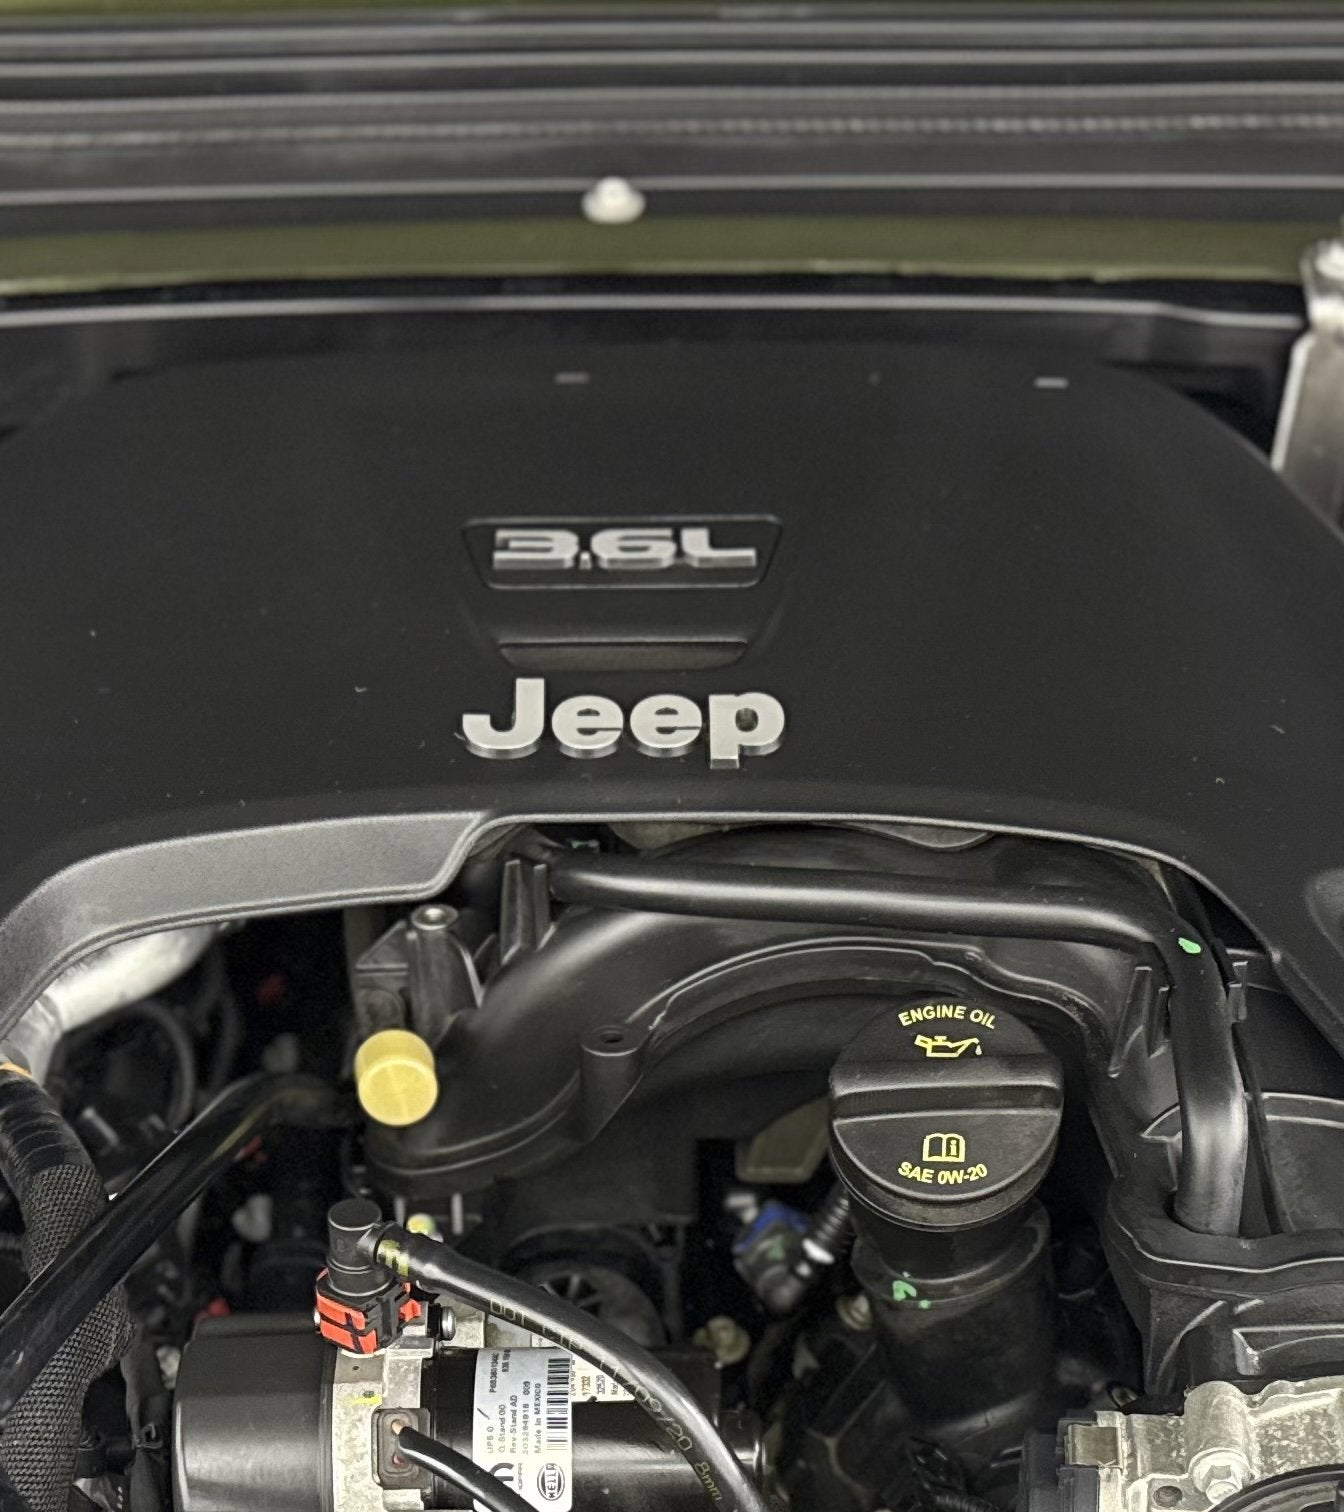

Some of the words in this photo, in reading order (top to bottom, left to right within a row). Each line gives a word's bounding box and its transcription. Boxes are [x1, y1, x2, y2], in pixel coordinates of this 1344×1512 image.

[492, 527, 757, 570] 3.6L
[462, 677, 785, 769] Jeep
[897, 1004, 968, 1027] ENGINE
[969, 1008, 996, 1030] OIL
[897, 1161, 935, 1185] SAE
[937, 1163, 988, 1185] 0W-20
[534, 1383, 542, 1415] MEXICO
[545, 1462, 557, 1499] HELLA
